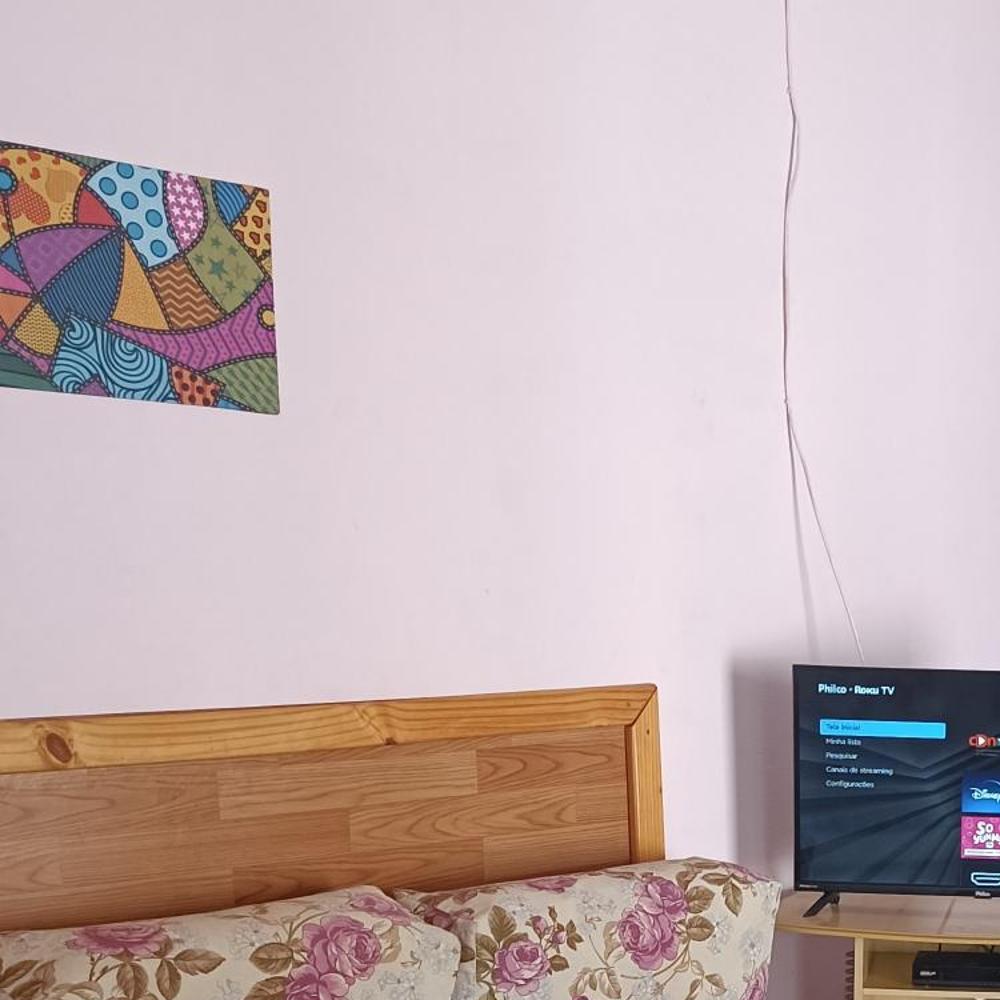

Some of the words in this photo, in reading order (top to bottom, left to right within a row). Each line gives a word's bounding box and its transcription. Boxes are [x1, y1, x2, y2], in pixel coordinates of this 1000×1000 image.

[818, 683, 847, 694] Philco
[854, 685, 879, 695] Roku
[881, 686, 895, 695] TV
[825, 766, 848, 774] Canais
[859, 768, 894, 776] streaming
[976, 820, 994, 836] So
